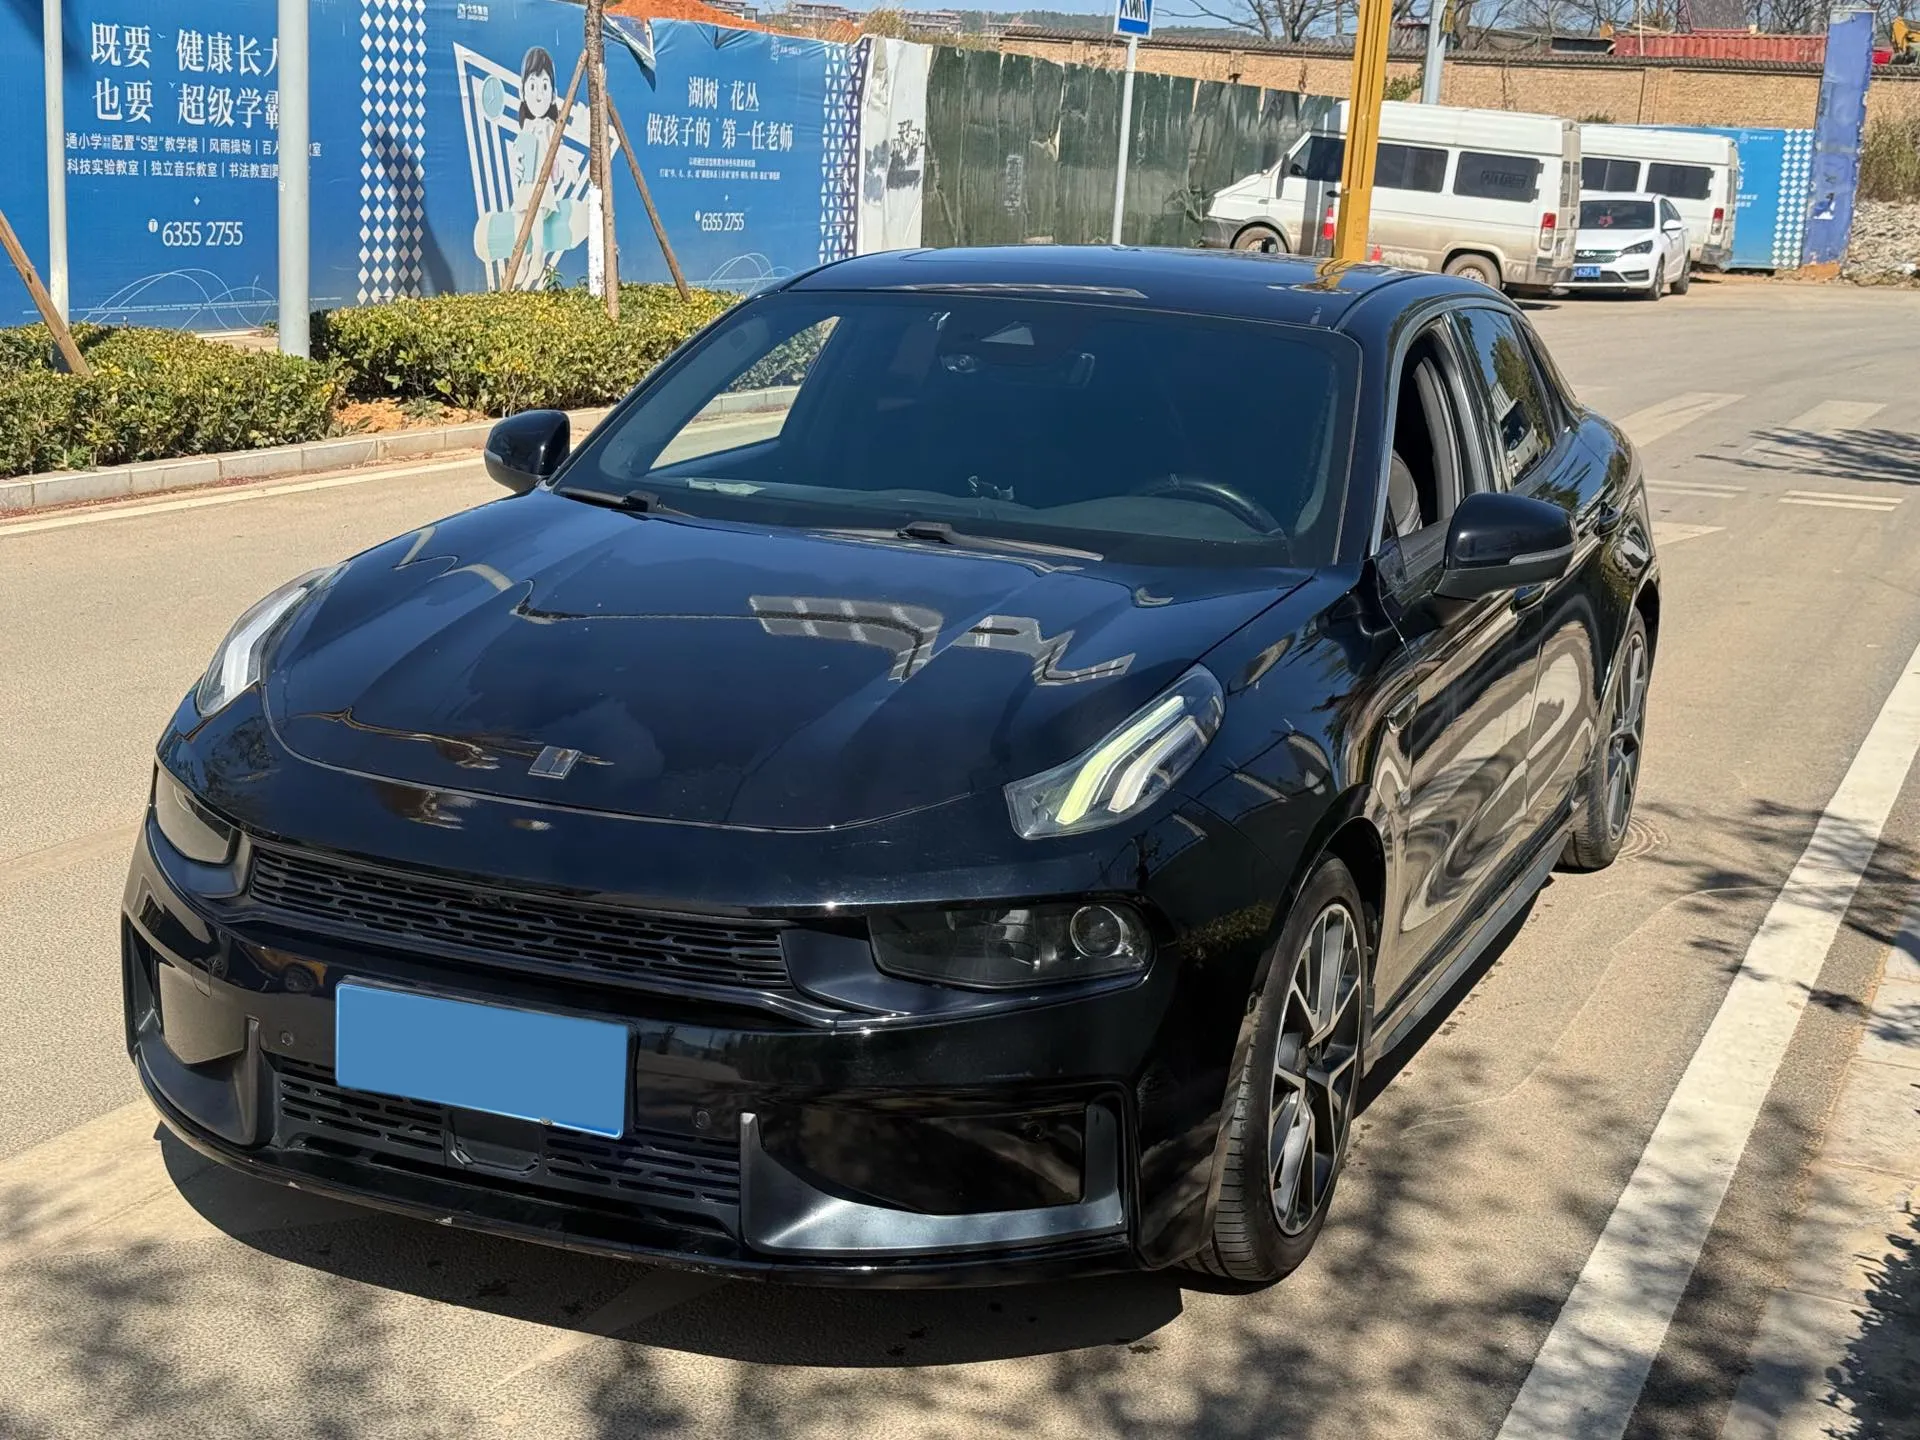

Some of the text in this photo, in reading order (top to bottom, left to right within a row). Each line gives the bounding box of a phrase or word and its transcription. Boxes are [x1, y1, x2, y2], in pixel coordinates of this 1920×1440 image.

[91, 21, 152, 69] 既要
[92, 77, 153, 124] 也要
[688, 76, 760, 112] 湖树 花丛
[647, 112, 793, 152] 做孩子的 第一任老师
[162, 221, 244, 247] 6355 2755
[702, 212, 745, 232] 6355 2755
